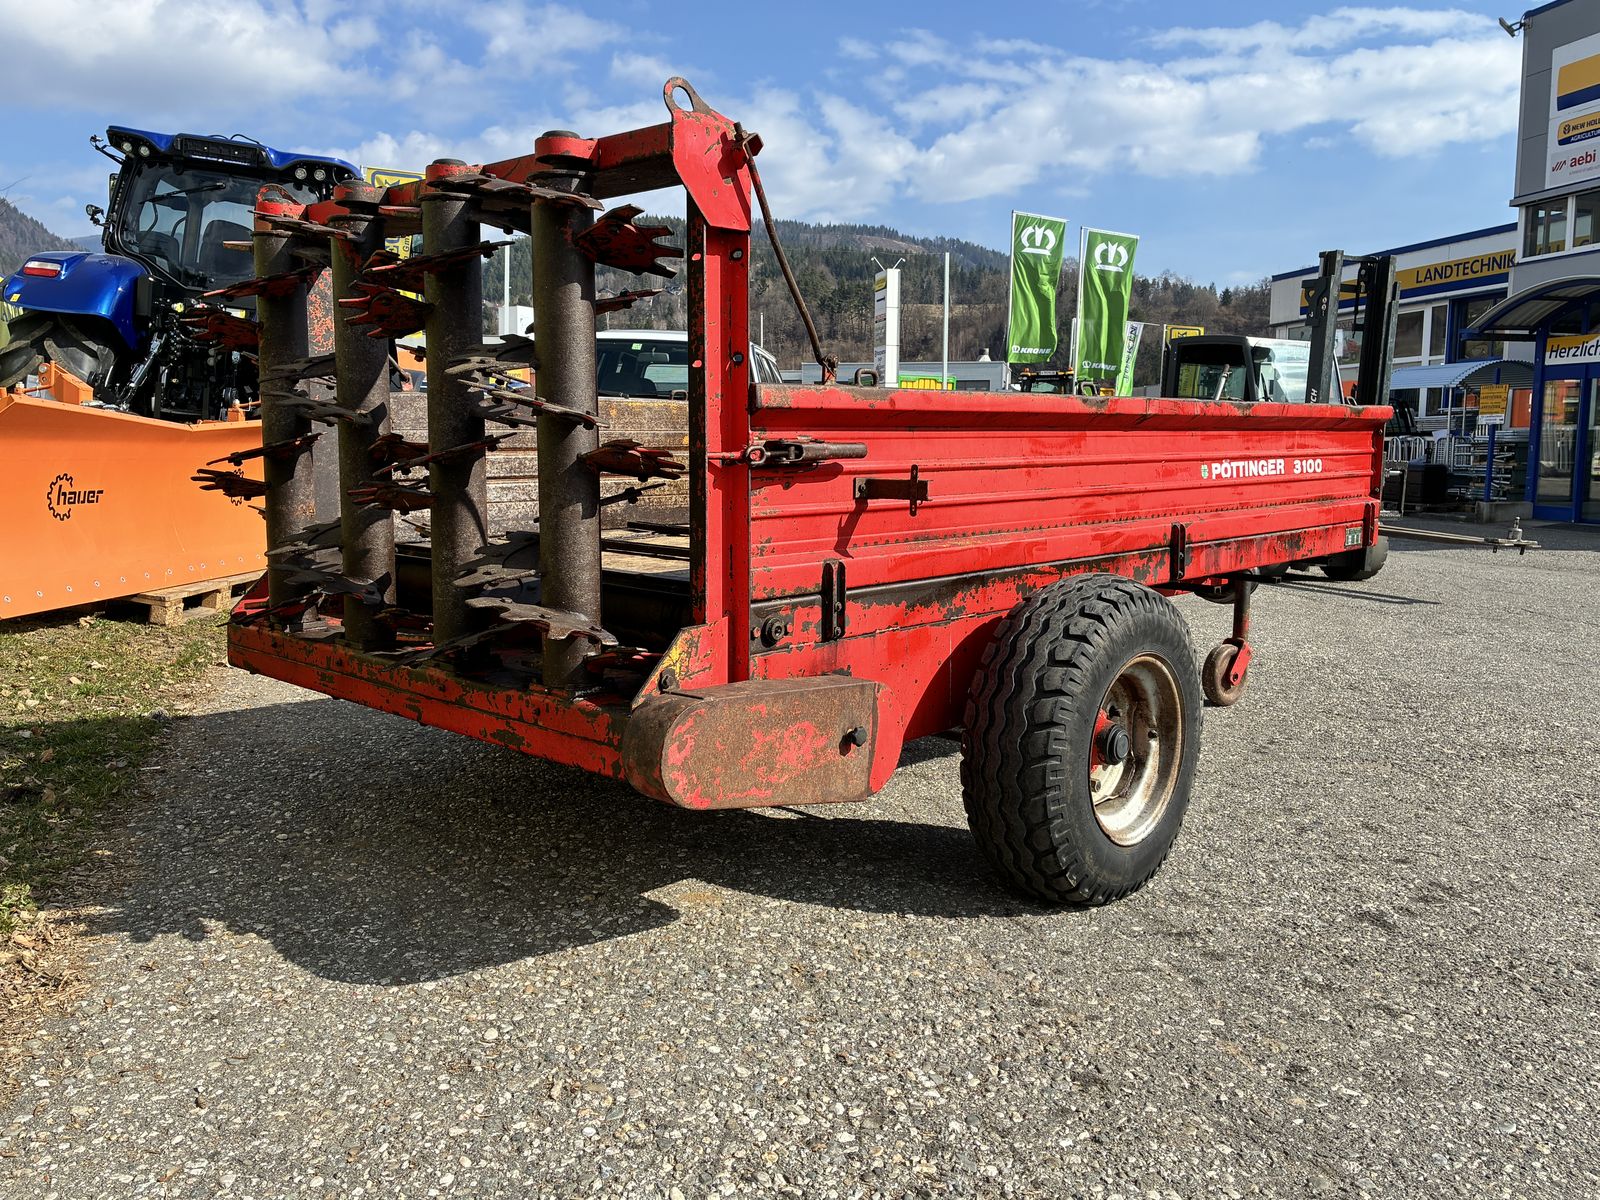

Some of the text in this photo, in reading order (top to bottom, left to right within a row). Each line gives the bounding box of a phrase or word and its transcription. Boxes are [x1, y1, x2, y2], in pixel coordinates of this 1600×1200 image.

[1571, 122, 1586, 132] NEW
[1569, 149, 1597, 168] aebi
[1415, 252, 1517, 284] LANDTECHNIK
[1211, 458, 1323, 480] PÖTTINGER 3100
[56, 484, 104, 506] hauer
